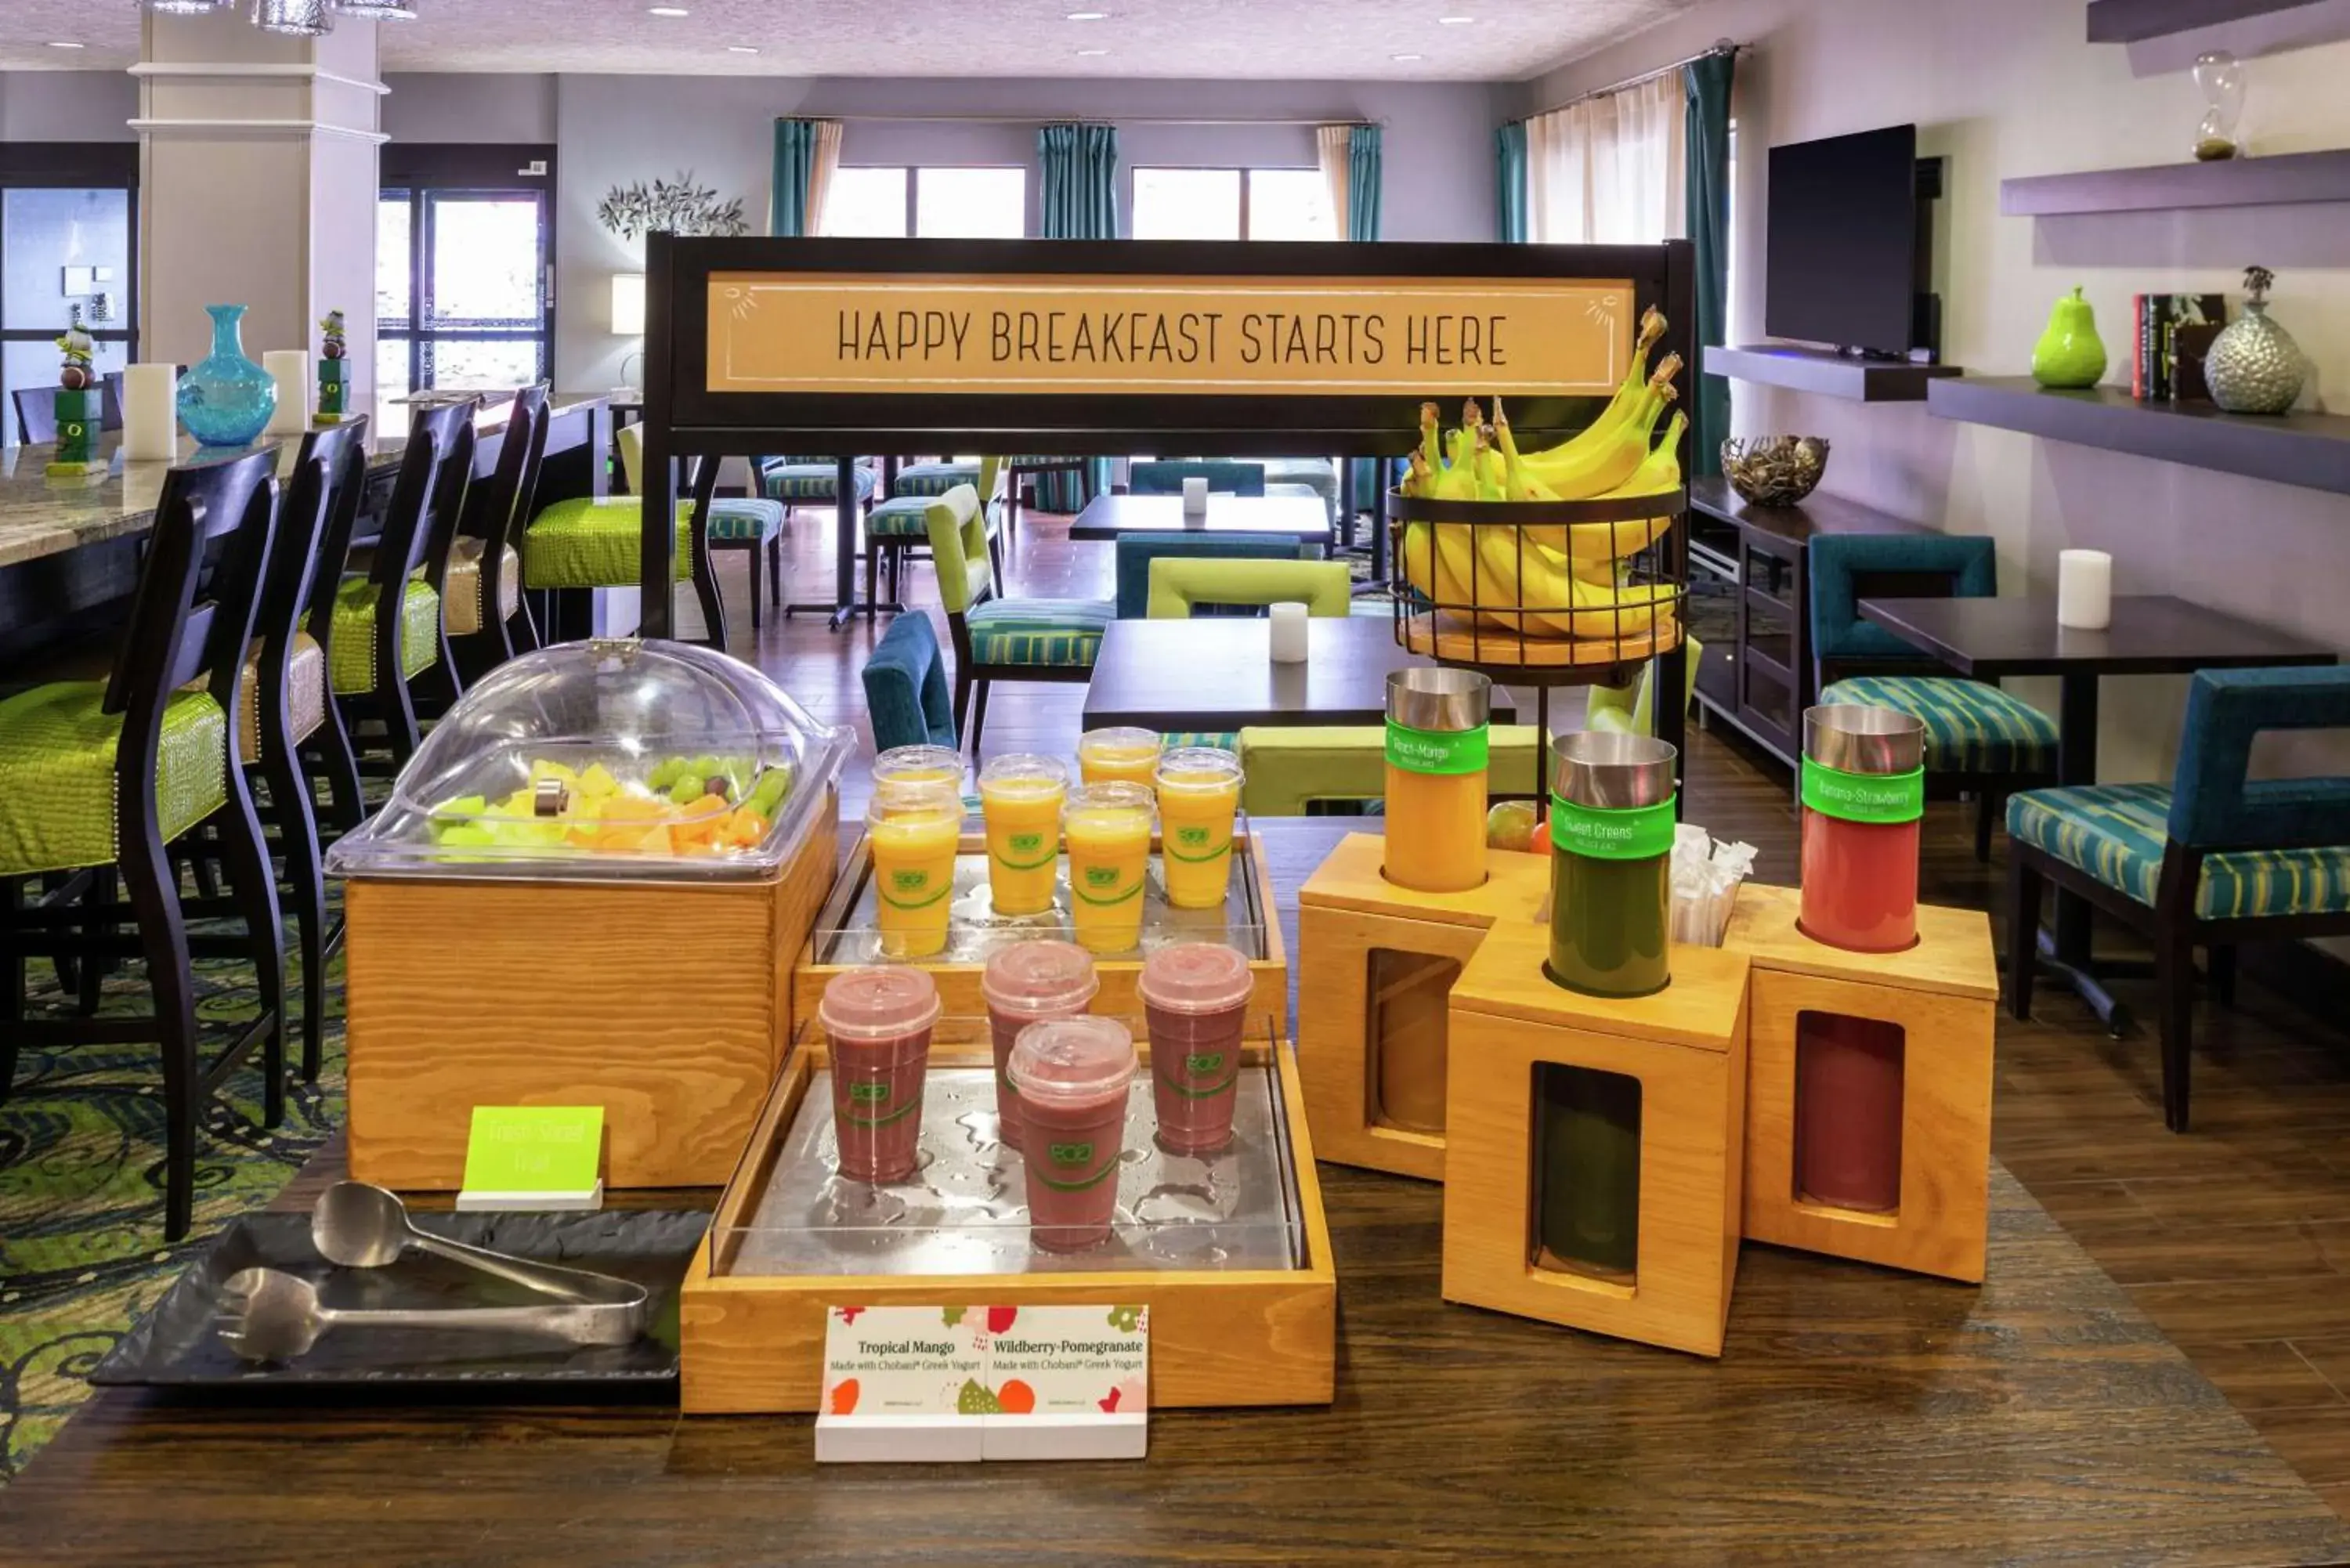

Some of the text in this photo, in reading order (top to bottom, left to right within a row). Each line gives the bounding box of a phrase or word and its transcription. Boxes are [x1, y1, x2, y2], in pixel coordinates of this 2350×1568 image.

[839, 309, 1507, 366] HAPPY BREAKFAST STARTS HERE
[1564, 815, 1633, 840] Sweet Greens
[858, 1340, 956, 1357] Tropical Mango
[994, 1340, 1144, 1356] Wildberry-Pomegranate
[830, 1360, 855, 1371] Made
[857, 1360, 877, 1371] with
[922, 1360, 949, 1371] Greek
[951, 1360, 981, 1371] Yogurt
[993, 1360, 1018, 1371] Made
[1020, 1360, 1039, 1370] with
[1084, 1359, 1112, 1370] Greek
[1113, 1359, 1144, 1371] Yogurt
